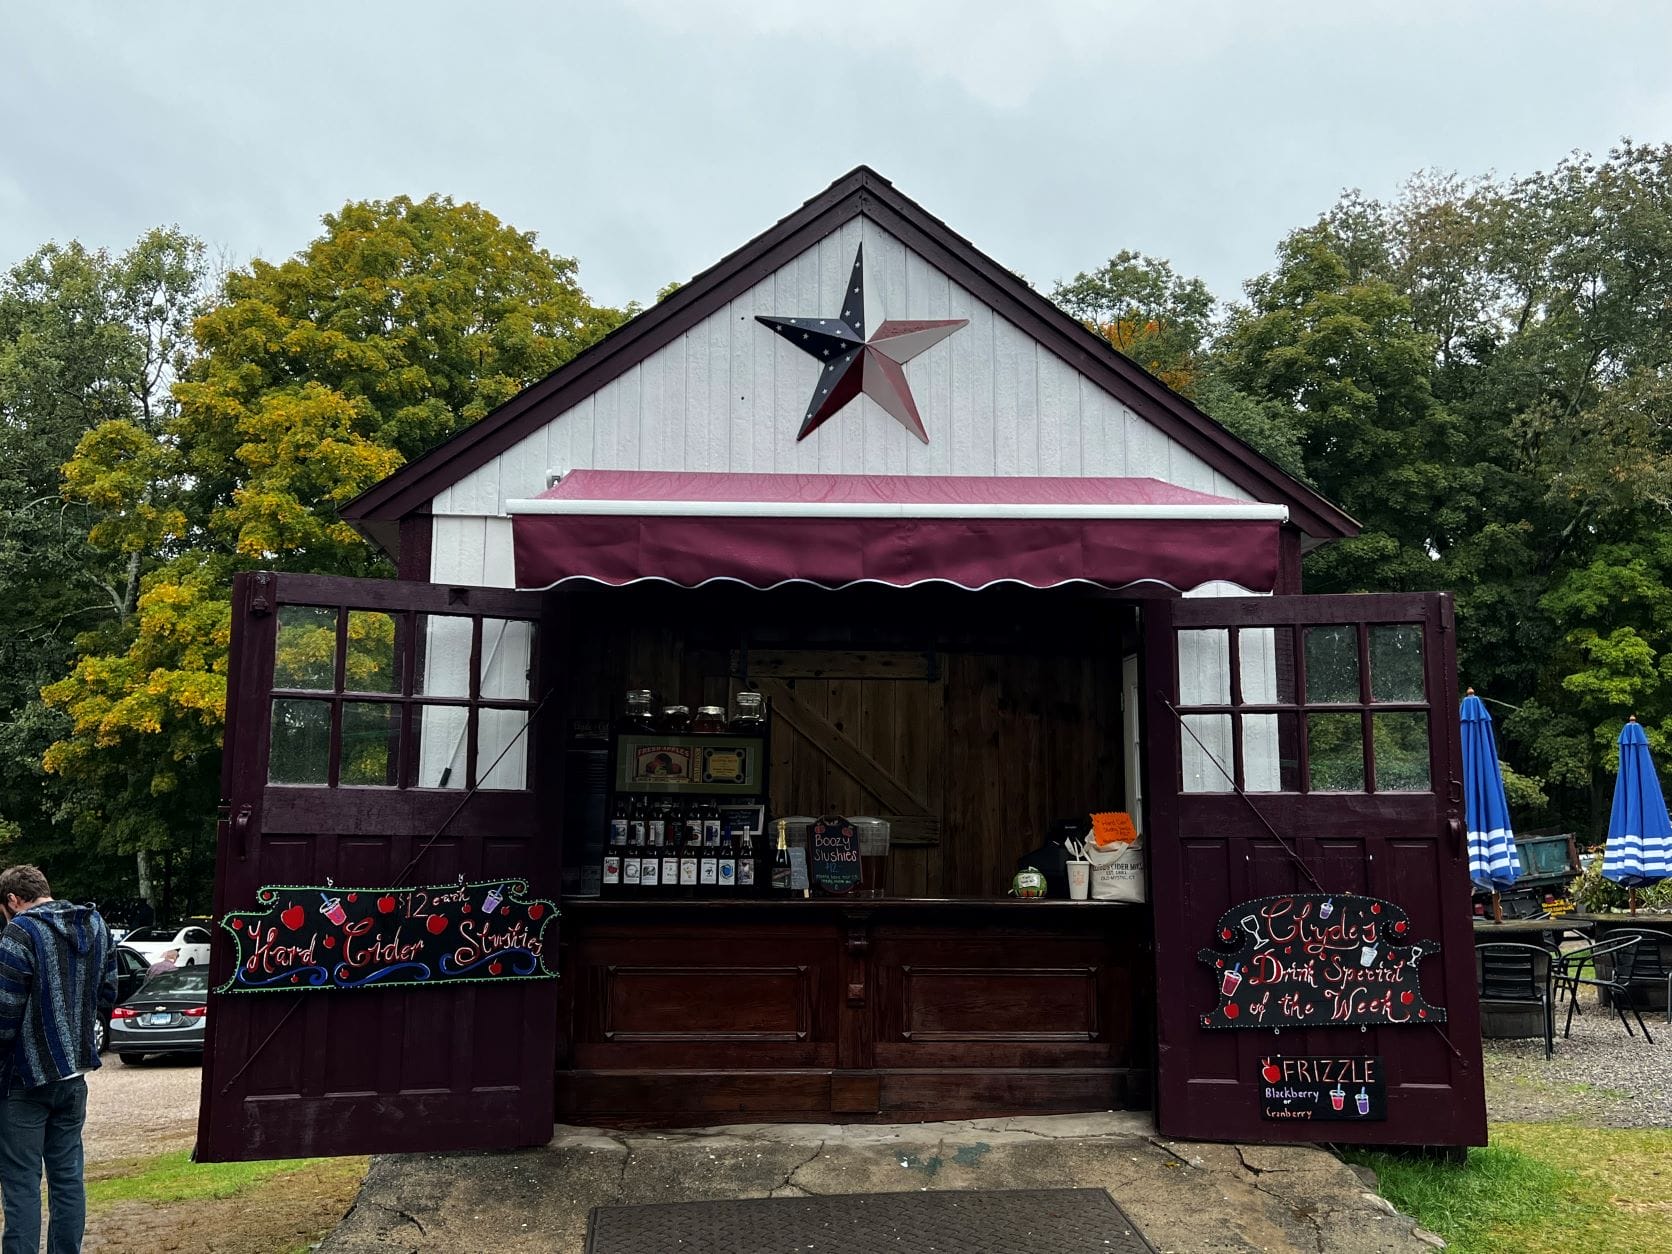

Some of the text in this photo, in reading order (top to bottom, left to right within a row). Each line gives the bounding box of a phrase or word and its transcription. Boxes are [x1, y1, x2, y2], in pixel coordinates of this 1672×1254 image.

[814, 849, 857, 862] Slushies
[815, 834, 850, 850] Boozy
[398, 887, 470, 919] $12 each
[1261, 898, 1378, 953] Clyde's
[246, 917, 544, 973] Hard Cider Slushies
[1250, 949, 1404, 990] Drink Special
[1250, 987, 1411, 1023] of the Week
[1283, 1059, 1376, 1083] FRIZZLE
[1265, 1087, 1319, 1103] Blackberry
[1266, 1106, 1313, 1119] Cranberry
